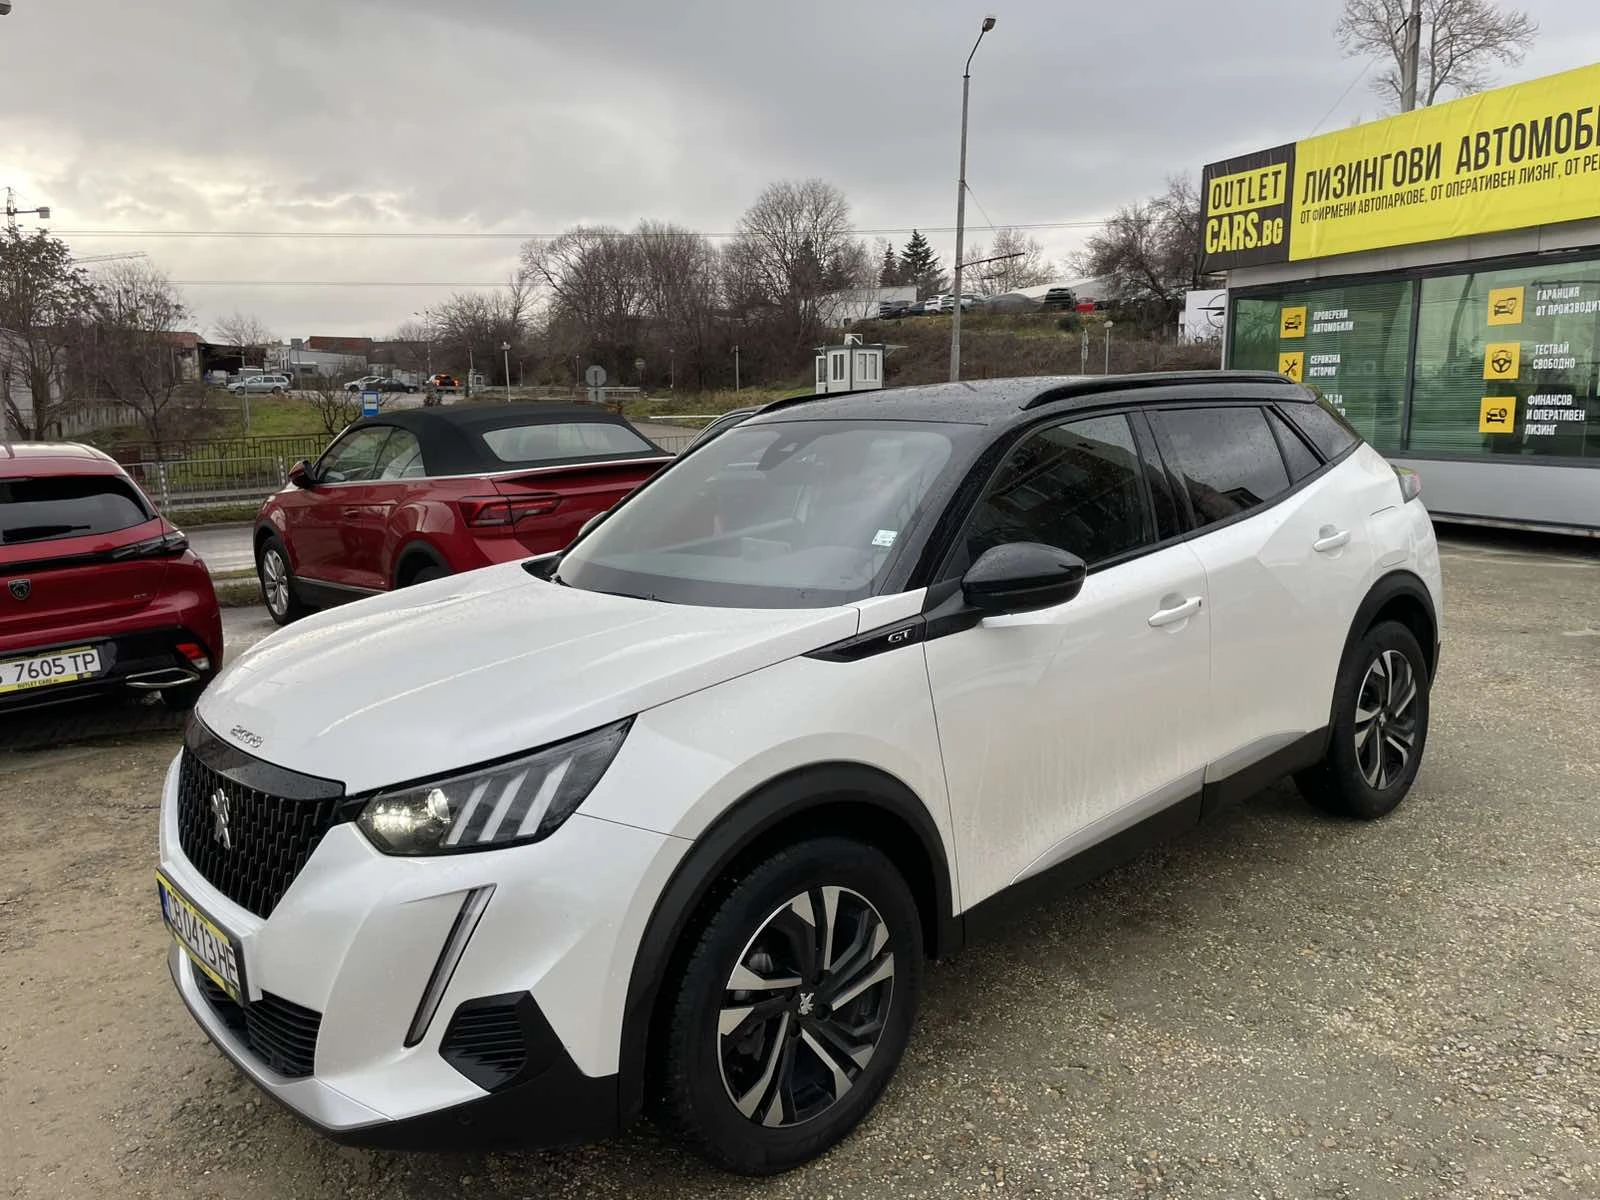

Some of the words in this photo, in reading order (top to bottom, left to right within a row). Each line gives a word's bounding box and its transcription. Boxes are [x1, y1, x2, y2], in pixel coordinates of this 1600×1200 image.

[1302, 141, 1442, 206] ЛИЗИНГОВИ
[1455, 104, 1600, 175] АВТОМОБ
[1213, 170, 1281, 210] OUTLET
[1300, 210, 1311, 224] ОТ
[1312, 201, 1357, 222] ФИРМЕНИ
[1358, 188, 1428, 214] АВТОПАРКОВЕ,
[1431, 184, 1444, 201] ОТ
[1445, 169, 1516, 198] ОПЕРАТИВЕН
[1565, 157, 1580, 176] ОТ
[1583, 153, 1600, 173] РЕ
[1206, 211, 1284, 254] CARS.BG
[1536, 286, 1580, 301] ГАРАНЦИЯ
[1312, 309, 1348, 321] ПРОВЕРЕНИ
[1535, 305, 1546, 316] ОТ
[1311, 321, 1354, 333] АВТОМОБИЛИ
[1535, 341, 1570, 355] ТЕСТВАЙ
[1310, 354, 1341, 364] СЕРВИЗНА
[1532, 358, 1576, 370] СВОБОДНО
[1309, 366, 1336, 377] ИСТОРИЯ
[1527, 394, 1573, 406] ФИНАНСОВ
[1533, 409, 1585, 421] ОПЕРАТИВЕН
[1525, 424, 1558, 436] ЛИЗИНГ
[887, 628, 913, 643] GT
[14, 657, 66, 682] 7605
